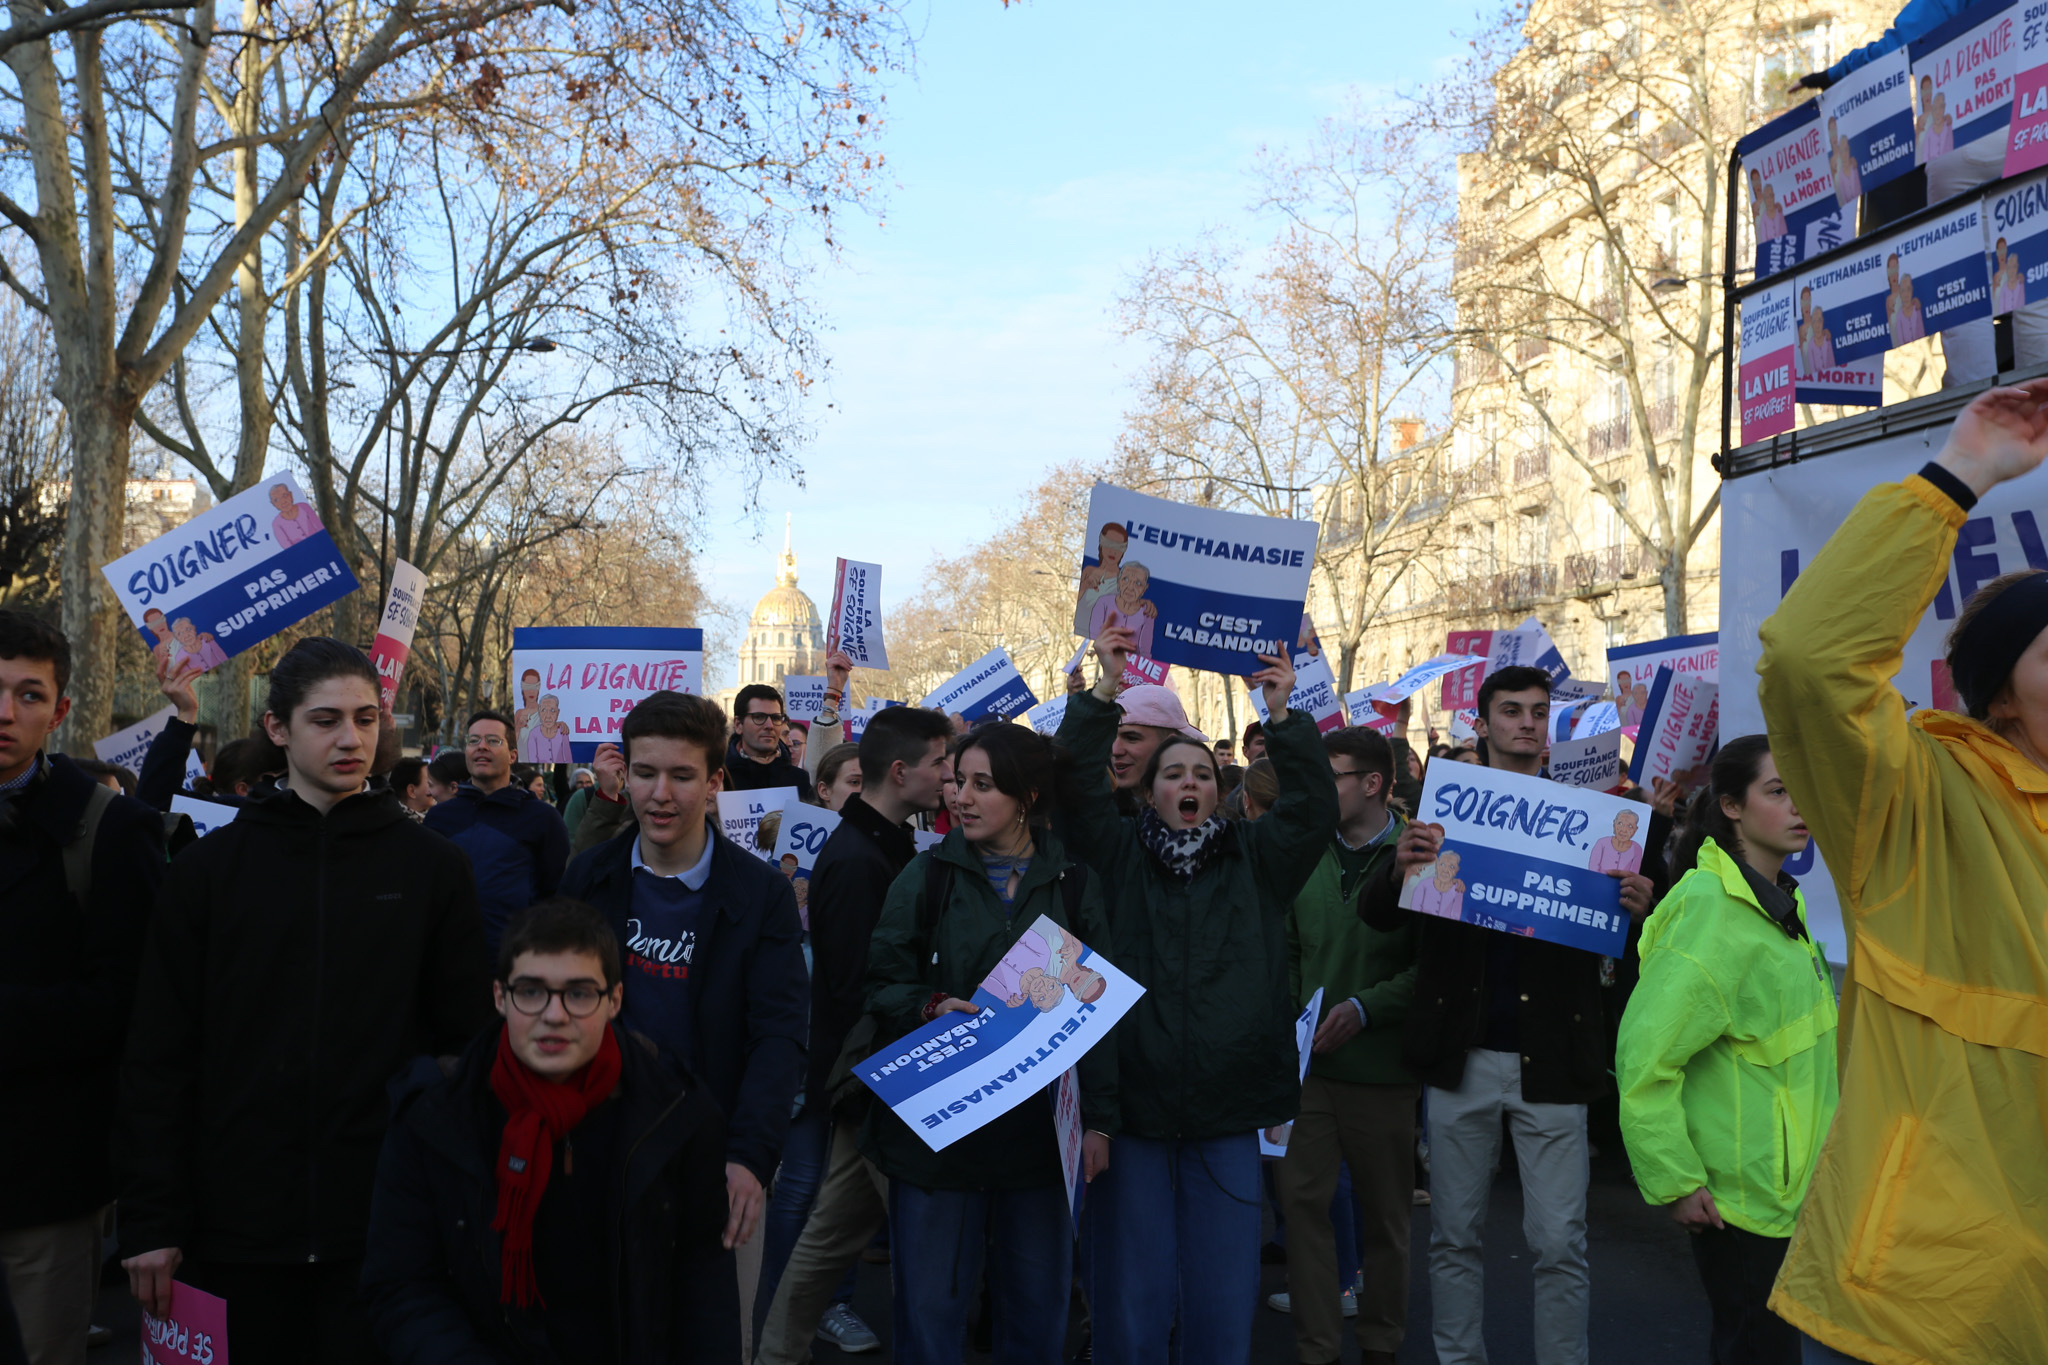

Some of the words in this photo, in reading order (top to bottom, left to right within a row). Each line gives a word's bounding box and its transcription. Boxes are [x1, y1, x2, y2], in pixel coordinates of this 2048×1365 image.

[2023, 21, 2042, 51] SE
[1936, 58, 1951, 89] LA
[1975, 68, 1996, 90] PAS
[1833, 70, 1905, 120] L'EUTHANASIE
[1956, 102, 1973, 120] LA
[1975, 77, 2012, 111] MORT
[1870, 133, 1896, 156] C'EST
[2014, 128, 2028, 151] SE
[1760, 156, 1775, 181] LA
[1795, 168, 1813, 184] PAS
[1783, 193, 1797, 207] LA
[1896, 212, 1978, 258] L'EUTHANASIE
[1809, 254, 1882, 292] L'EUTHANASIE
[1762, 292, 1771, 305] LA
[1937, 277, 1966, 299] C'EST
[1743, 296, 1790, 327] SOUFFRANCE
[1846, 313, 1873, 332] C'EST
[1743, 326, 1754, 349] SE
[1745, 376, 1763, 400] LA
[1764, 365, 1789, 392] VIE
[1817, 370, 1867, 384] MORT
[1744, 408, 1754, 426] SE
[1126, 520, 1305, 567] L'EUTHANASIE
[244, 568, 287, 599] PAS
[849, 566, 858, 591] SE
[387, 601, 401, 620] SE
[856, 568, 868, 662] SOUFFRANCE
[865, 609, 872, 627] LA
[1200, 612, 1262, 634] C'EST
[546, 663, 572, 690] LA
[1137, 656, 1162, 680] VIE
[1635, 663, 1653, 681] LA
[938, 659, 1007, 707] L'EUTHANASIE
[789, 699, 803, 711] SE
[987, 693, 1012, 713] C'EST
[1352, 708, 1361, 719] SE
[136, 729, 152, 742] LA
[575, 716, 602, 733] LA
[1688, 713, 1703, 738] PAS
[1554, 749, 1618, 772] SOUFFRANCE
[1584, 746, 1597, 756] LA
[1693, 743, 1708, 762] LA
[1653, 752, 1672, 775] LA
[749, 803, 765, 814] LA
[1523, 870, 1572, 897] PAS
[917, 1035, 979, 1073] C'EST
[921, 1003, 1097, 1130] L'EUTHANASIE
[191, 1332, 214, 1365] SE
